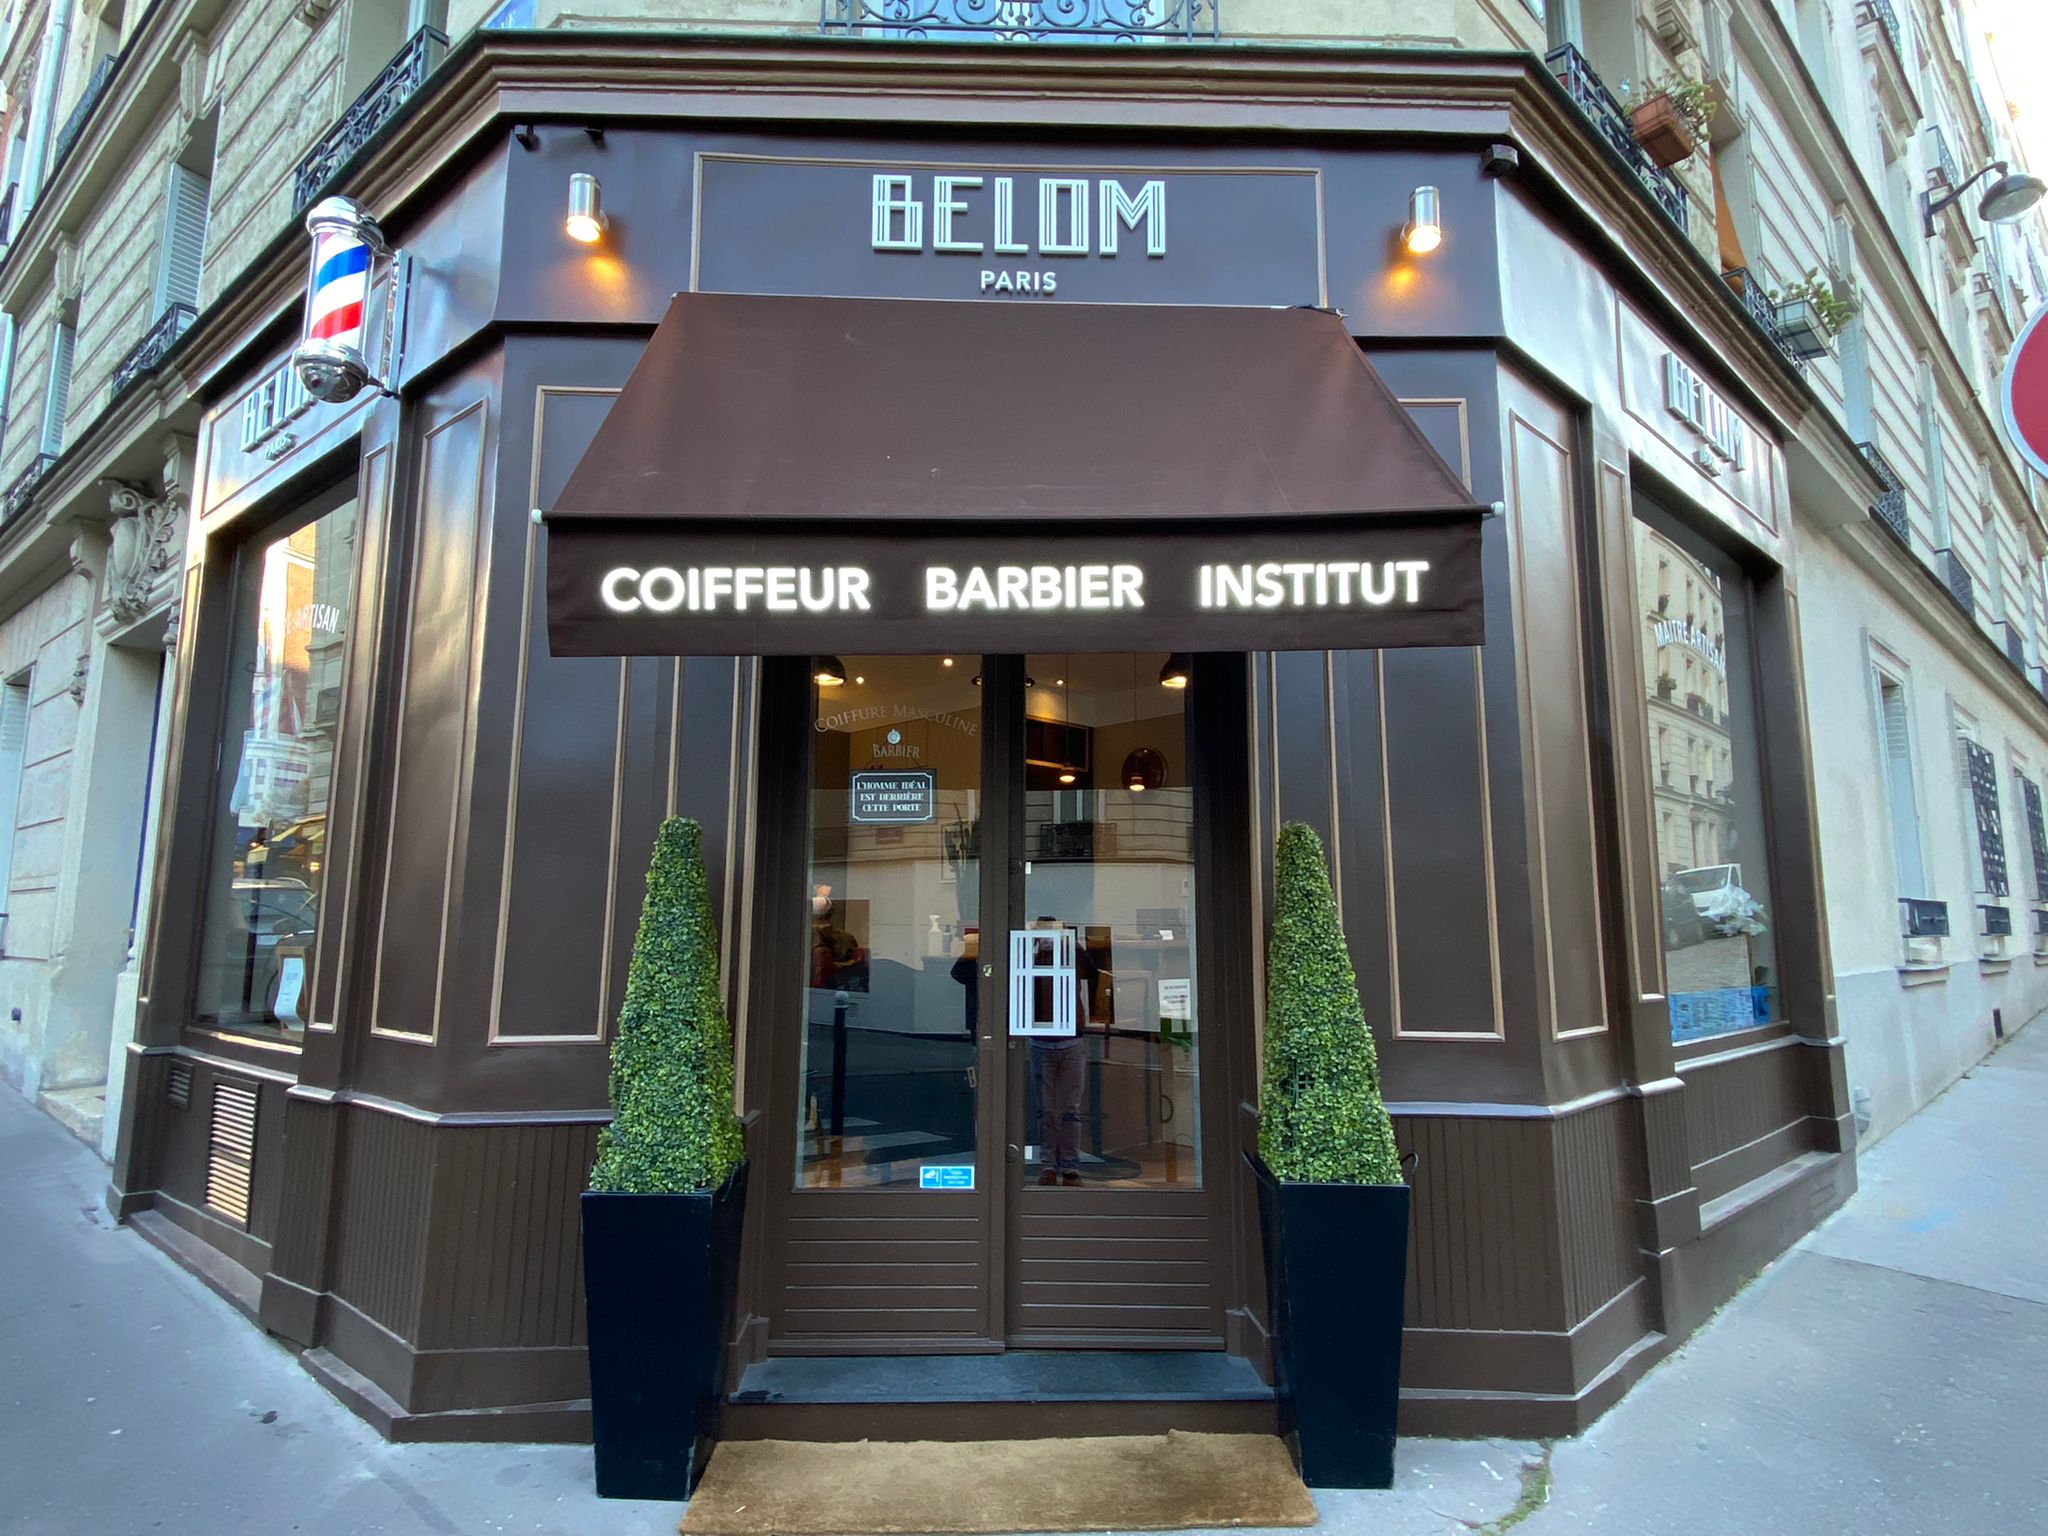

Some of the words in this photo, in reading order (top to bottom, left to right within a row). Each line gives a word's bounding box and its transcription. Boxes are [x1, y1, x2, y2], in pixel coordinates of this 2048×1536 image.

[872, 175, 1166, 257] BELOM
[980, 270, 1057, 293] PARIS
[600, 567, 871, 612] COIFFEUR
[925, 566, 1145, 610] BARBIER
[1200, 561, 1430, 608] INSTITUT
[814, 705, 887, 733] COIFFURE
[892, 704, 979, 737] MASCULINE
[872, 743, 921, 759] BARBIER
[856, 781, 899, 790] L'HOMME
[901, 780, 926, 790] IDÉAL
[860, 793, 877, 801] EST
[879, 792, 924, 801] DERRIÈRE
[862, 804, 890, 812] CETTE
[892, 804, 921, 812] PORTE
